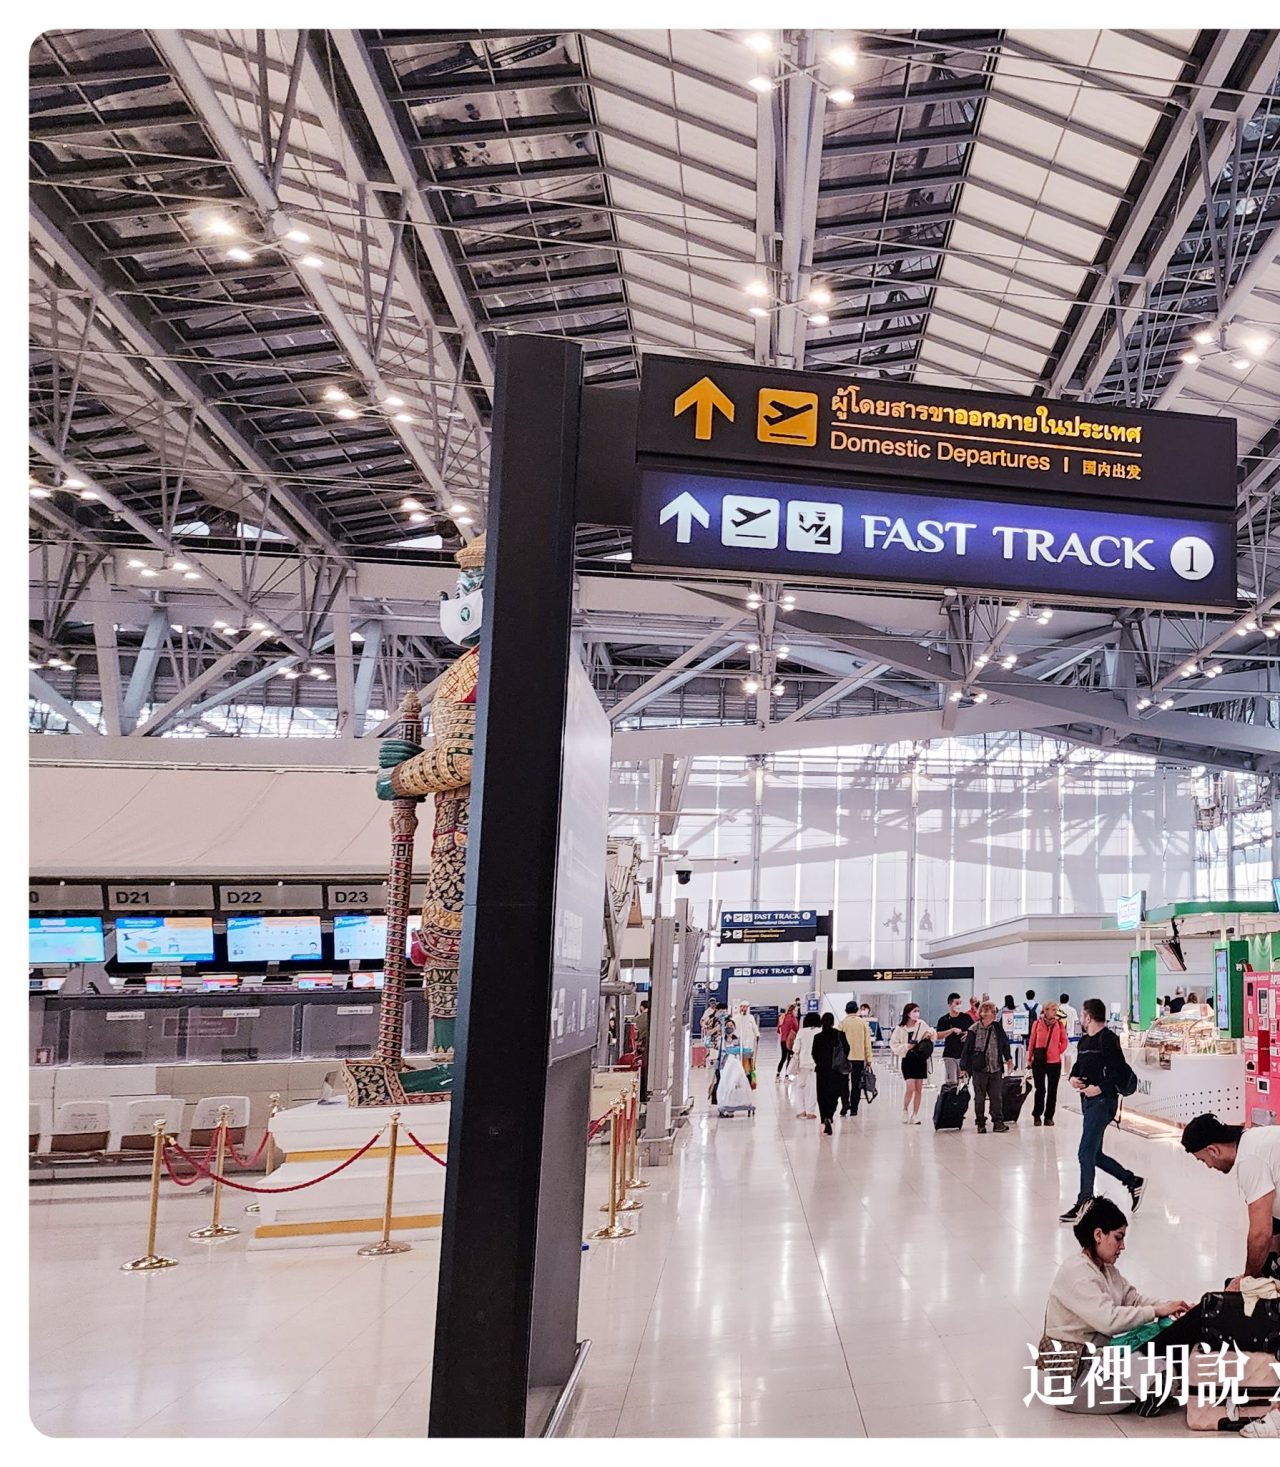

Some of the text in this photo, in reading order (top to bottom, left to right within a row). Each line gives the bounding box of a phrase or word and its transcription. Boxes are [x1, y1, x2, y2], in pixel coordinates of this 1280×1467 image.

[831, 384, 1142, 443] ผู้โดยสารขาออกภายในประเทศ
[830, 431, 1050, 470] Domestic Departures
[1082, 459, 1142, 480] 国内出发
[861, 513, 1199, 573] FAST TRACK 1
[116, 891, 150, 904] D21
[227, 891, 262, 904] D22
[335, 891, 368, 903] D23
